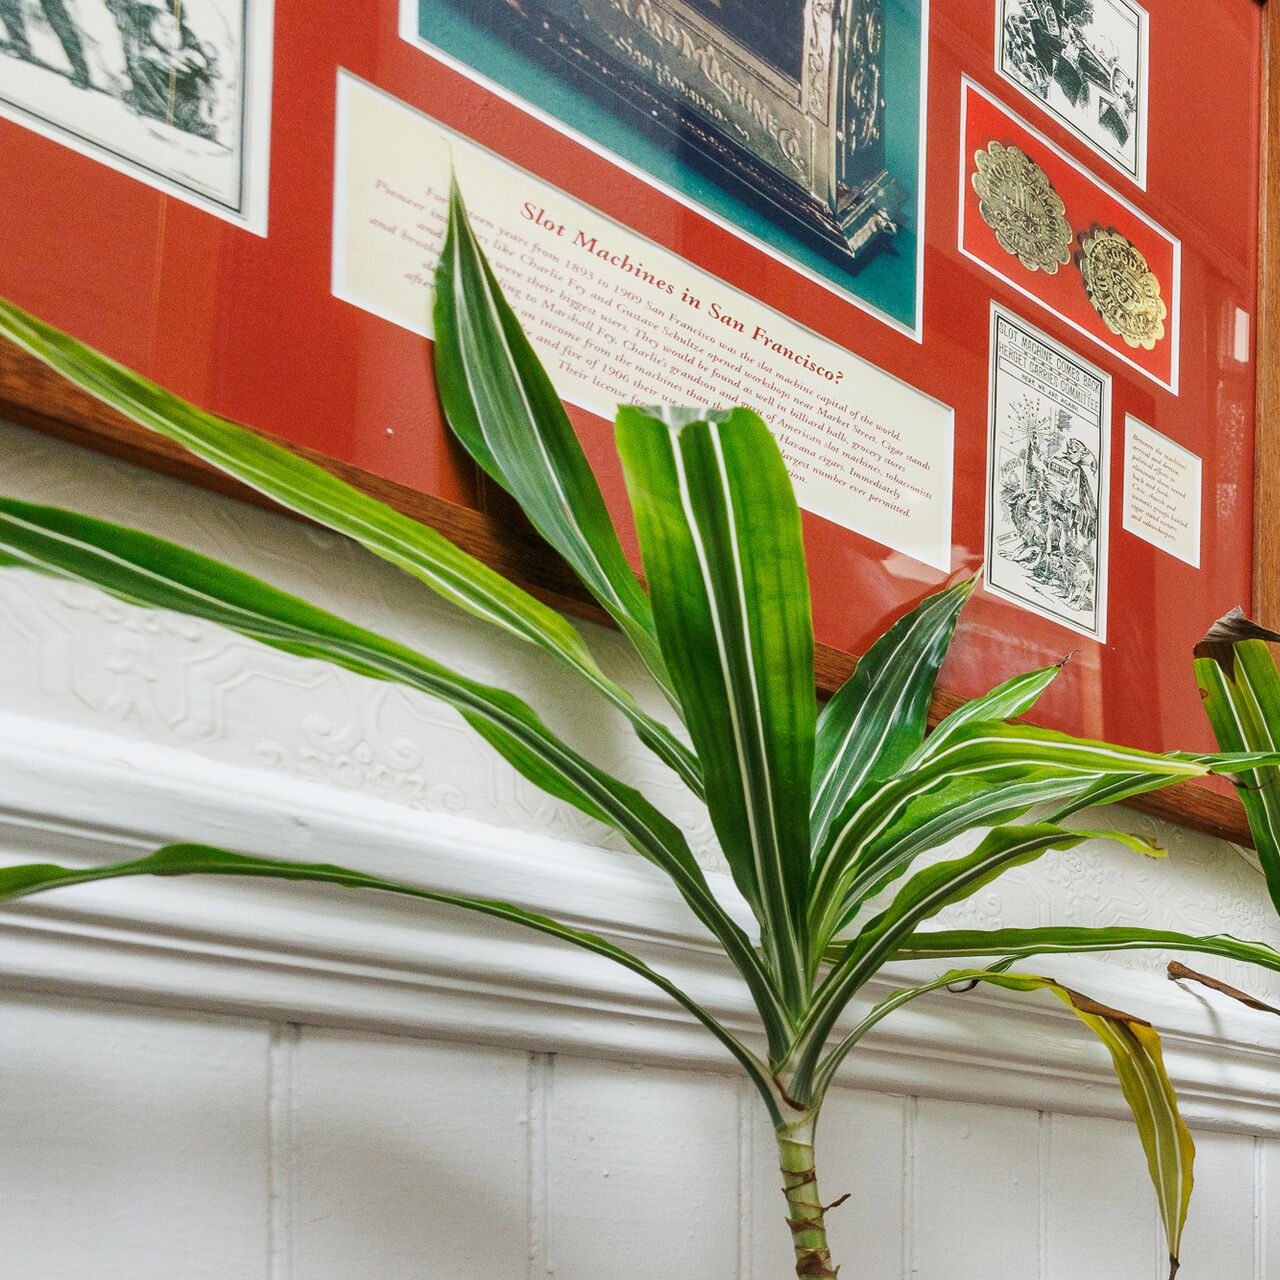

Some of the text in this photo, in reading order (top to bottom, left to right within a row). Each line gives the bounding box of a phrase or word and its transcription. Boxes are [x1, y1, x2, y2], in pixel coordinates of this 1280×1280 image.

[368, 218, 395, 234] and
[525, 293, 537, 303] to
[541, 298, 593, 331] Marshall
[596, 326, 617, 344] Fey.
[622, 339, 666, 367] Charlie's
[669, 365, 716, 392] grandson
[718, 391, 739, 409] and
[765, 413, 776, 423] of
[777, 418, 821, 444] American
[824, 441, 839, 453] slot
[841, 450, 882, 475] machines,
[885, 472, 931, 499] tobacconists
[373, 178, 425, 210] Pioneer
[492, 239, 514, 256] like
[519, 253, 563, 281] Charlie
[567, 277, 586, 295] Fey
[589, 293, 612, 307] and
[615, 302, 658, 330] Gustave
[663, 325, 704, 353] Schultze
[707, 352, 741, 373] opened
[743, 370, 790, 398] workshops
[793, 396, 813, 410] near
[816, 406, 849, 428] Market
[853, 424, 876, 442] Street.
[881, 439, 903, 456] Cigar
[906, 454, 930, 470] stands
[416, 223, 442, 240] and
[495, 260, 523, 278] were
[526, 275, 555, 293] their
[558, 289, 596, 315] biggest
[600, 313, 628, 332] users.
[635, 328, 659, 348] They
[662, 345, 695, 365] would
[697, 359, 708, 372] be
[710, 367, 741, 388] found
[742, 386, 752, 395] as
[755, 392, 775, 406] well
[776, 403, 786, 412] in
[789, 407, 824, 431] billiard
[826, 425, 848, 443] halls,
[851, 441, 881, 461] grocery
[884, 457, 905, 472] stores
[425, 186, 900, 441] For years from 1893 to 1909 San Francisco was the slot machine capital of the world.
[520, 202, 843, 384] Slot Machines in San Francisco?
[558, 359, 627, 398] Their license
[997, 341, 1098, 412] HERGET CARRIES COMMITTEE
[998, 321, 1100, 394] SLOT MACHINE COMES BACK
[1021, 372, 1035, 387] HERE
[1037, 382, 1046, 393] WE
[404, 273, 434, 295] after
[535, 335, 560, 350] and
[561, 344, 582, 360] fire
[585, 358, 599, 369] of
[601, 363, 629, 382] 1906
[632, 379, 657, 395] their
[661, 394, 677, 408] use
[781, 448, 809, 469] largest
[812, 466, 846, 486] number
[848, 484, 870, 501] ever
[868, 493, 910, 517] permitted.
[520, 309, 535, 321] on
[539, 318, 580, 342] income
[582, 338, 610, 357] from
[614, 353, 630, 366] the
[634, 364, 682, 391] machines
[685, 388, 706, 404] than
[779, 433, 816, 457] Havana
[818, 455, 845, 471] cigars.
[849, 466, 900, 499] Immediately
